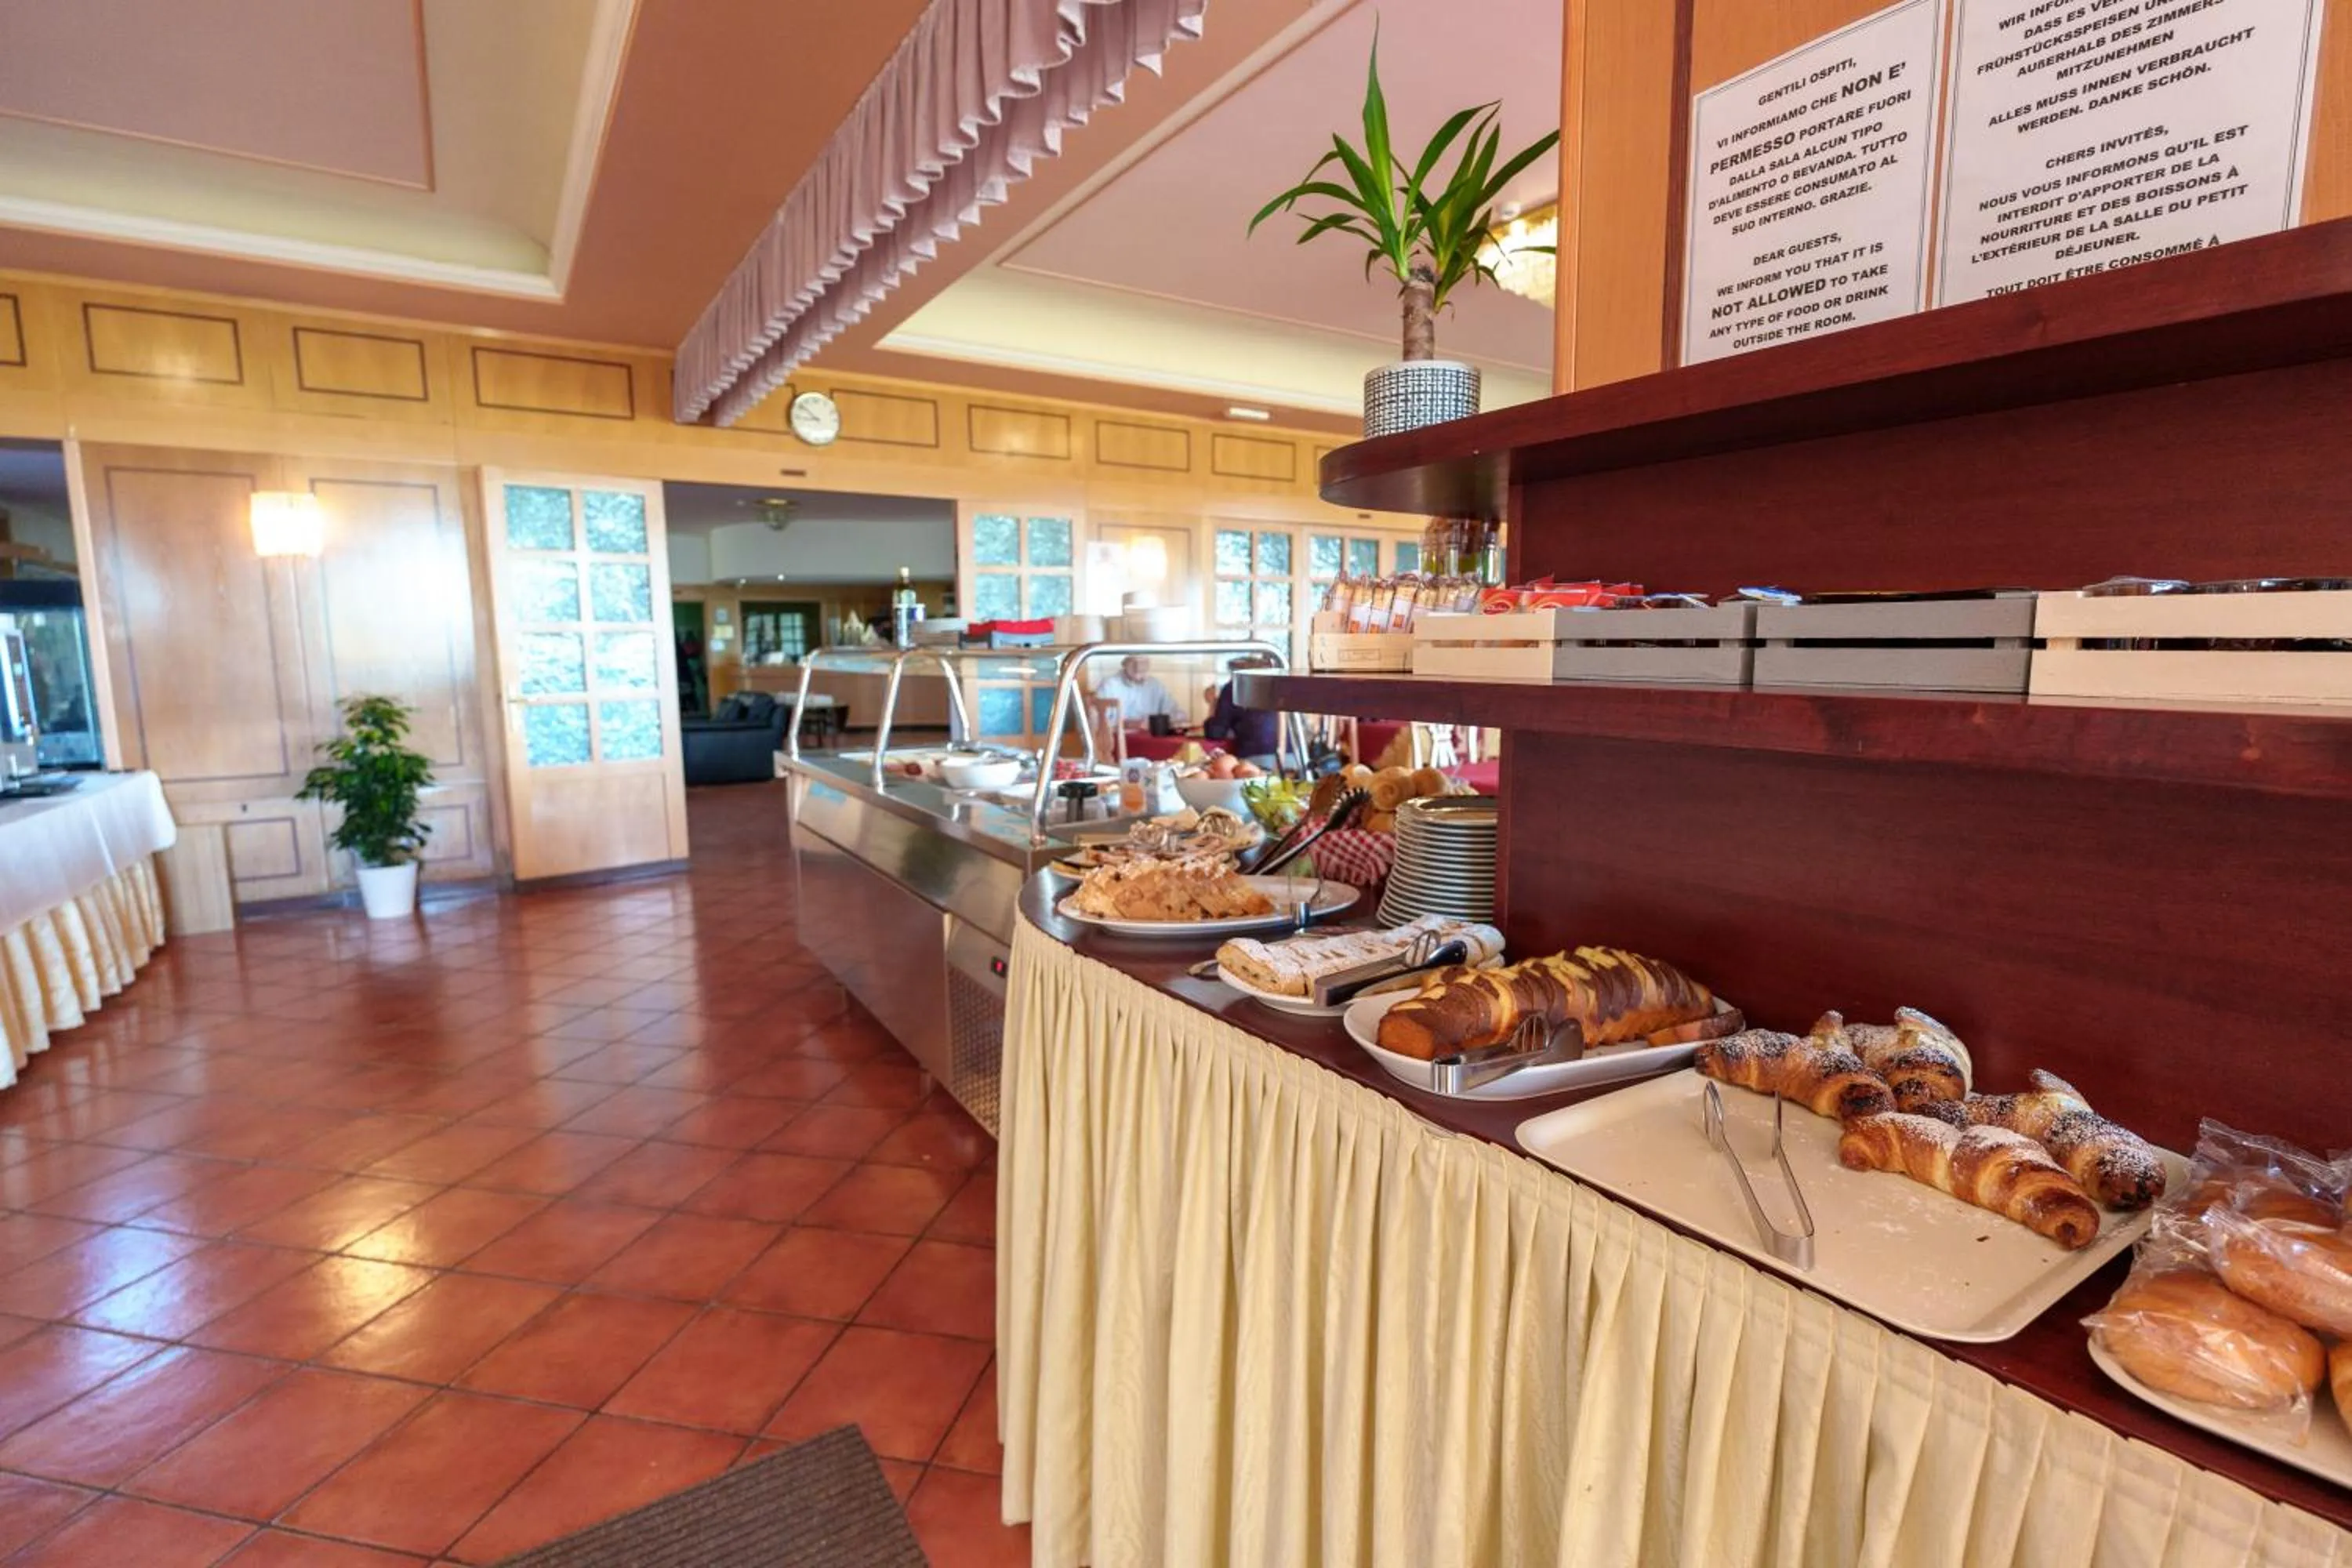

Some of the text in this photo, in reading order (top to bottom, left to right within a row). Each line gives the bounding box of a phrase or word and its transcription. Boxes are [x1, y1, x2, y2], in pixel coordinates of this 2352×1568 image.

[1976, 5, 2140, 76] FRÜHSTÜCKSSPEISEN
[1998, 12, 2026, 31] WIR
[2024, 16, 2063, 40] DASS
[2066, 7, 2086, 23] ES
[2111, 23, 2143, 43] DES
[1758, 57, 1857, 106] GENTILI OSPITI,
[1988, 26, 2256, 127] ALLES MUSS INNEN VERBRAUCHT
[2056, 29, 2174, 81] MITZUNEHMEN
[1716, 137, 1729, 149] VI
[1731, 104, 1808, 143] INFORMIAMO
[1810, 92, 1838, 111] CHE
[1841, 71, 1882, 99] NON
[2017, 62, 2212, 134] WERDEN. DANKE SCHÖN.
[1710, 89, 1911, 176] PERMESSO PORTARE FUORI
[1729, 122, 1883, 187] DALLA SALA ALCUN TIPO
[2045, 125, 2169, 169] CHERS INVITÉS,
[1708, 131, 1907, 211] D'ALIMENTO O BEVANDA. TUTTO
[1713, 154, 1898, 225] DEVE ESSERE CONSUMATO AL
[1979, 125, 2249, 212] NOUS VOUS INFORMONS QU'IL EST
[1997, 153, 2220, 223] INTERDIT D'APPORTER DE LA
[1732, 181, 1872, 236] SUO INTERNO. GRAZIE.
[1971, 183, 2249, 264] L'EXTÉRIEUR DE LA SALLE DU PETIT
[1980, 211, 2073, 245] NOURRITURE
[2077, 205, 2097, 219] ET
[2100, 195, 2131, 212] DES
[2135, 172, 2222, 203] BOISSONS
[1716, 241, 1884, 297] WE INFORM YOU THAT IT IS
[1753, 232, 1842, 267] DEAR GUESTS,
[2055, 231, 2140, 260] DÉJEUNER.
[1708, 285, 1889, 339] ANY TYPE OF FOOD OR DRINK
[1711, 263, 1889, 320] NOT ALLOWED TO TAKE
[1986, 281, 2024, 298] TOUT
[2027, 272, 2062, 289] DOIT
[1733, 311, 1857, 349] OUTSIDE THE ROOM.
